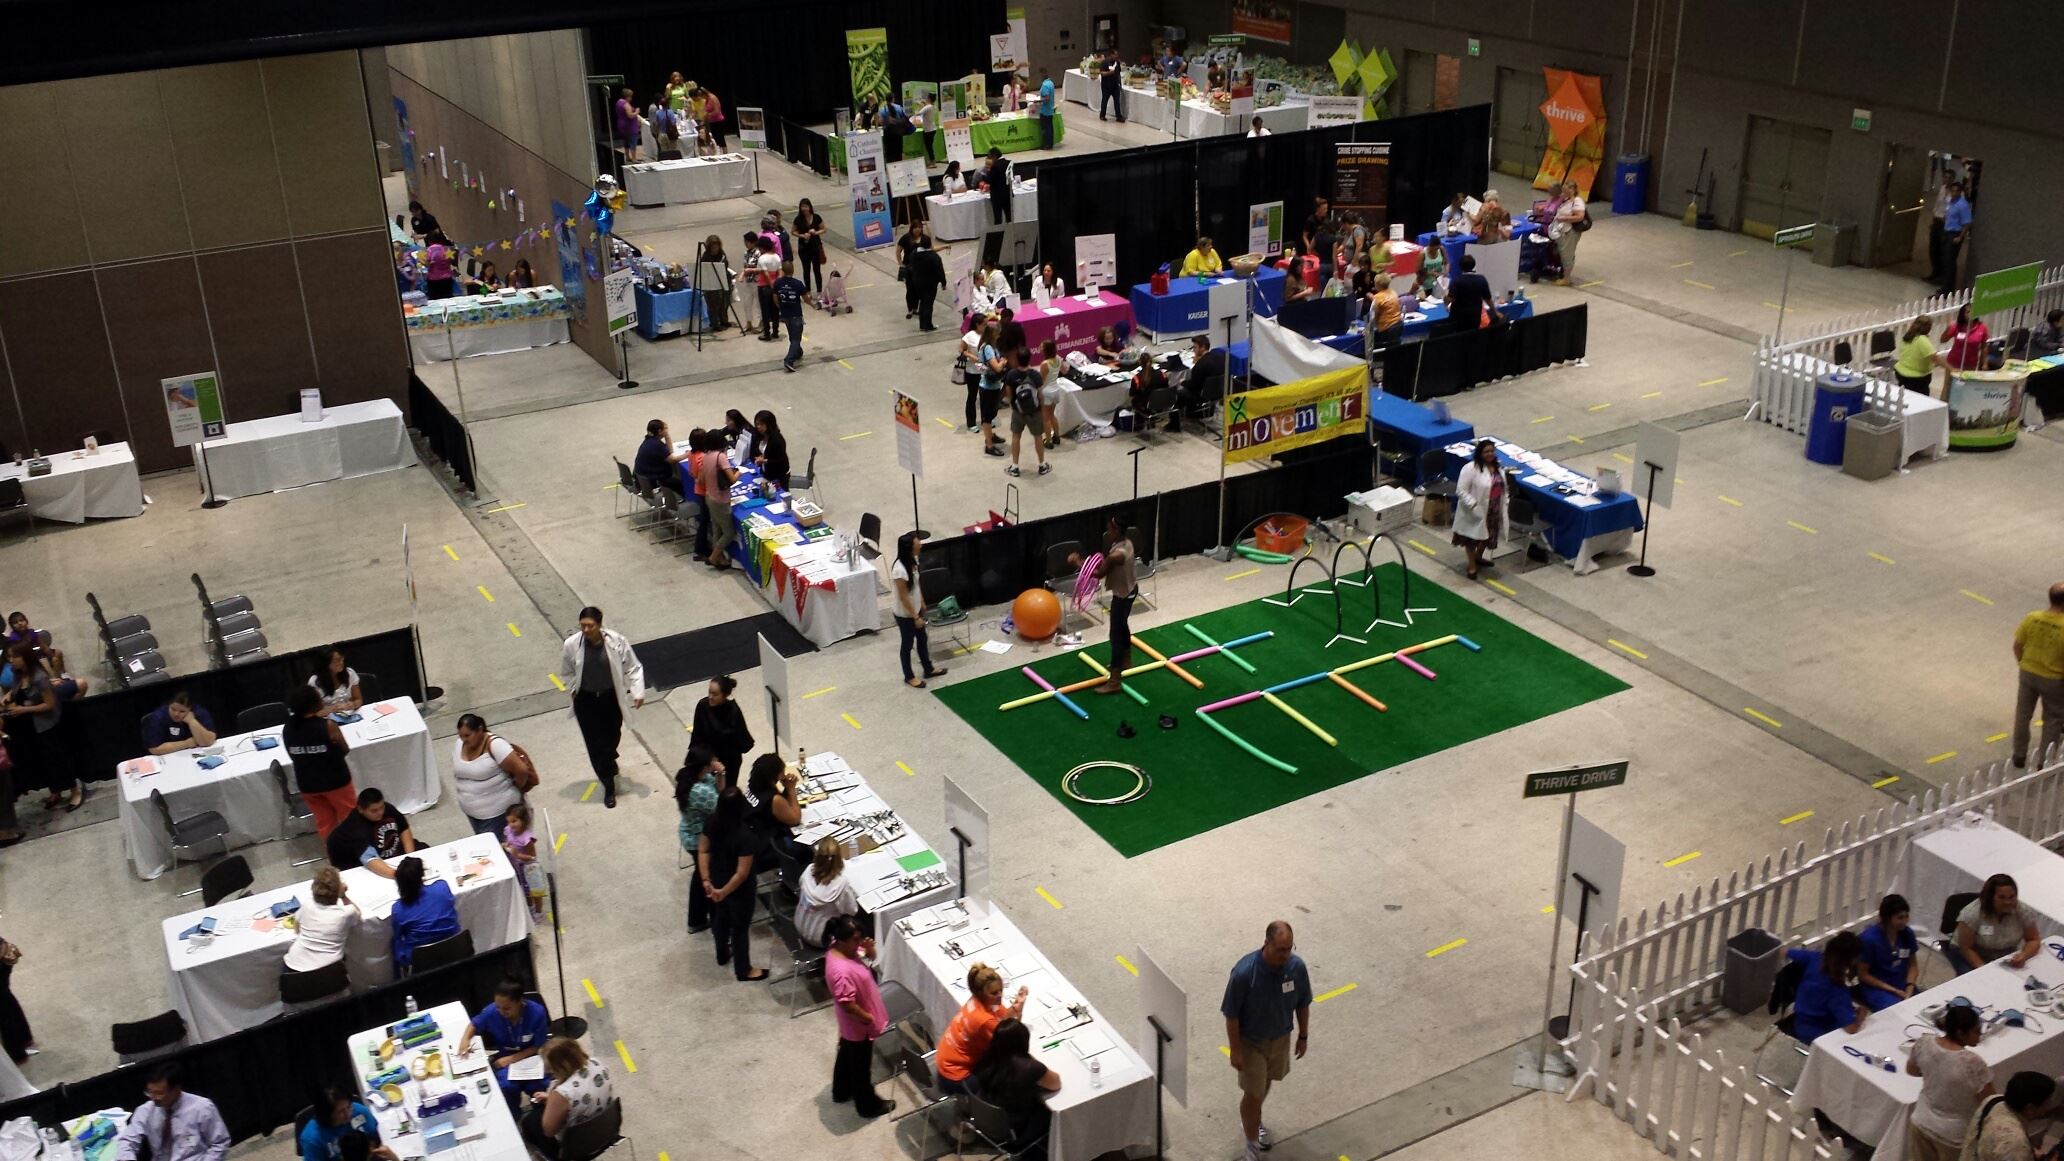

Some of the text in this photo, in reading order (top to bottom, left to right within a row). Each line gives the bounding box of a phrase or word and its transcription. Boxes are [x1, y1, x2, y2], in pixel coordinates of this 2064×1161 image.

[1547, 101, 1585, 123] thrive
[1336, 157, 1388, 166] PRIZE DRAWING
[1187, 311, 1209, 320] KAISER
[1534, 768, 1618, 790] THRIVE DRIVE
